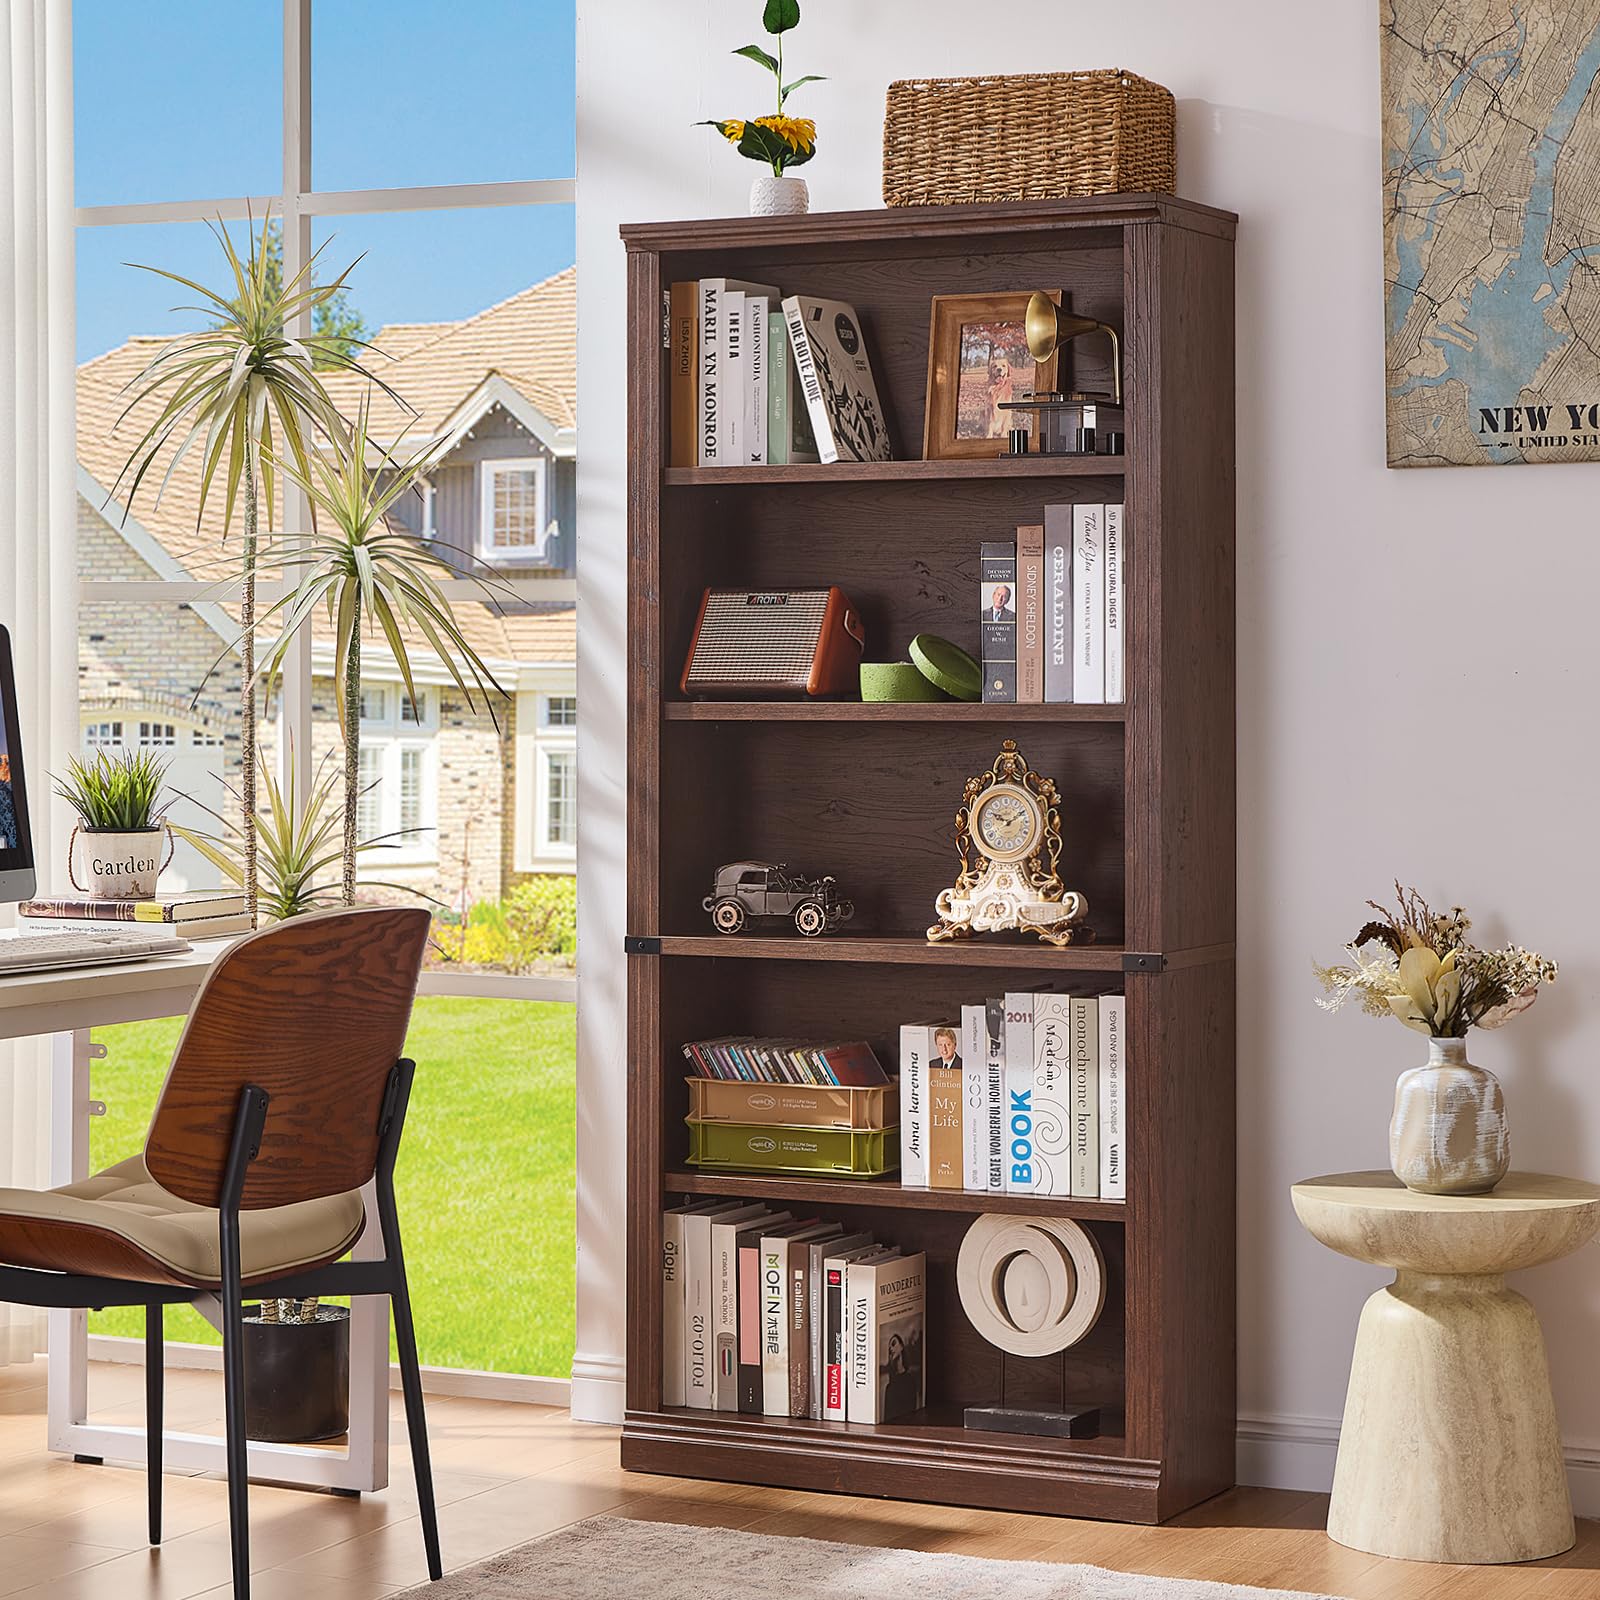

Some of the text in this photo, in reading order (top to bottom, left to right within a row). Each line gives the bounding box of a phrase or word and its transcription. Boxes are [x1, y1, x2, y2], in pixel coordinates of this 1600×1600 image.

[680, 319, 690, 374] LISA ZHOU
[752, 304, 761, 381] FASHIONINDIA
[790, 320, 805, 341] DIE
[704, 288, 717, 458] MARIL YN MONROE
[795, 342, 815, 372] ROTE
[803, 371, 822, 404] ZONE
[1478, 406, 1553, 434] NEW
[1518, 435, 1568, 448] UNITED
[1084, 513, 1098, 546] Thank
[1078, 547, 1096, 572] You
[1108, 524, 1117, 596] ARCHITECTURAL
[1026, 565, 1037, 600] SIDNEY
[1026, 602, 1037, 649] SHELDON
[1108, 598, 1117, 630] DIGEST
[92, 856, 154, 876] Garden
[1006, 1012, 1032, 1023] 2011
[1108, 1010, 1117, 1032] BAGS
[1046, 1024, 1056, 1091] Madame
[1077, 1005, 1091, 1108] monochrome
[1109, 1034, 1118, 1052] AND
[1109, 1053, 1118, 1078] SHOES
[908, 1052, 920, 1158] Anna karenina
[935, 1098, 956, 1114] My
[968, 1074, 982, 1109] COS
[1110, 1081, 1118, 1098] BEST
[934, 1114, 959, 1127] Life
[988, 1063, 1002, 1188] CREATE WONDERFUL HOMELIFE
[1011, 1088, 1032, 1184] BOOK
[1077, 1113, 1091, 1156] home
[1109, 1143, 1118, 1184] FASHION
[663, 1241, 675, 1281] PHOTO
[766, 1254, 781, 1314] MOFIN
[692, 1315, 705, 1388] FOLIO-02
[856, 1298, 867, 1388] WONDERFUL
